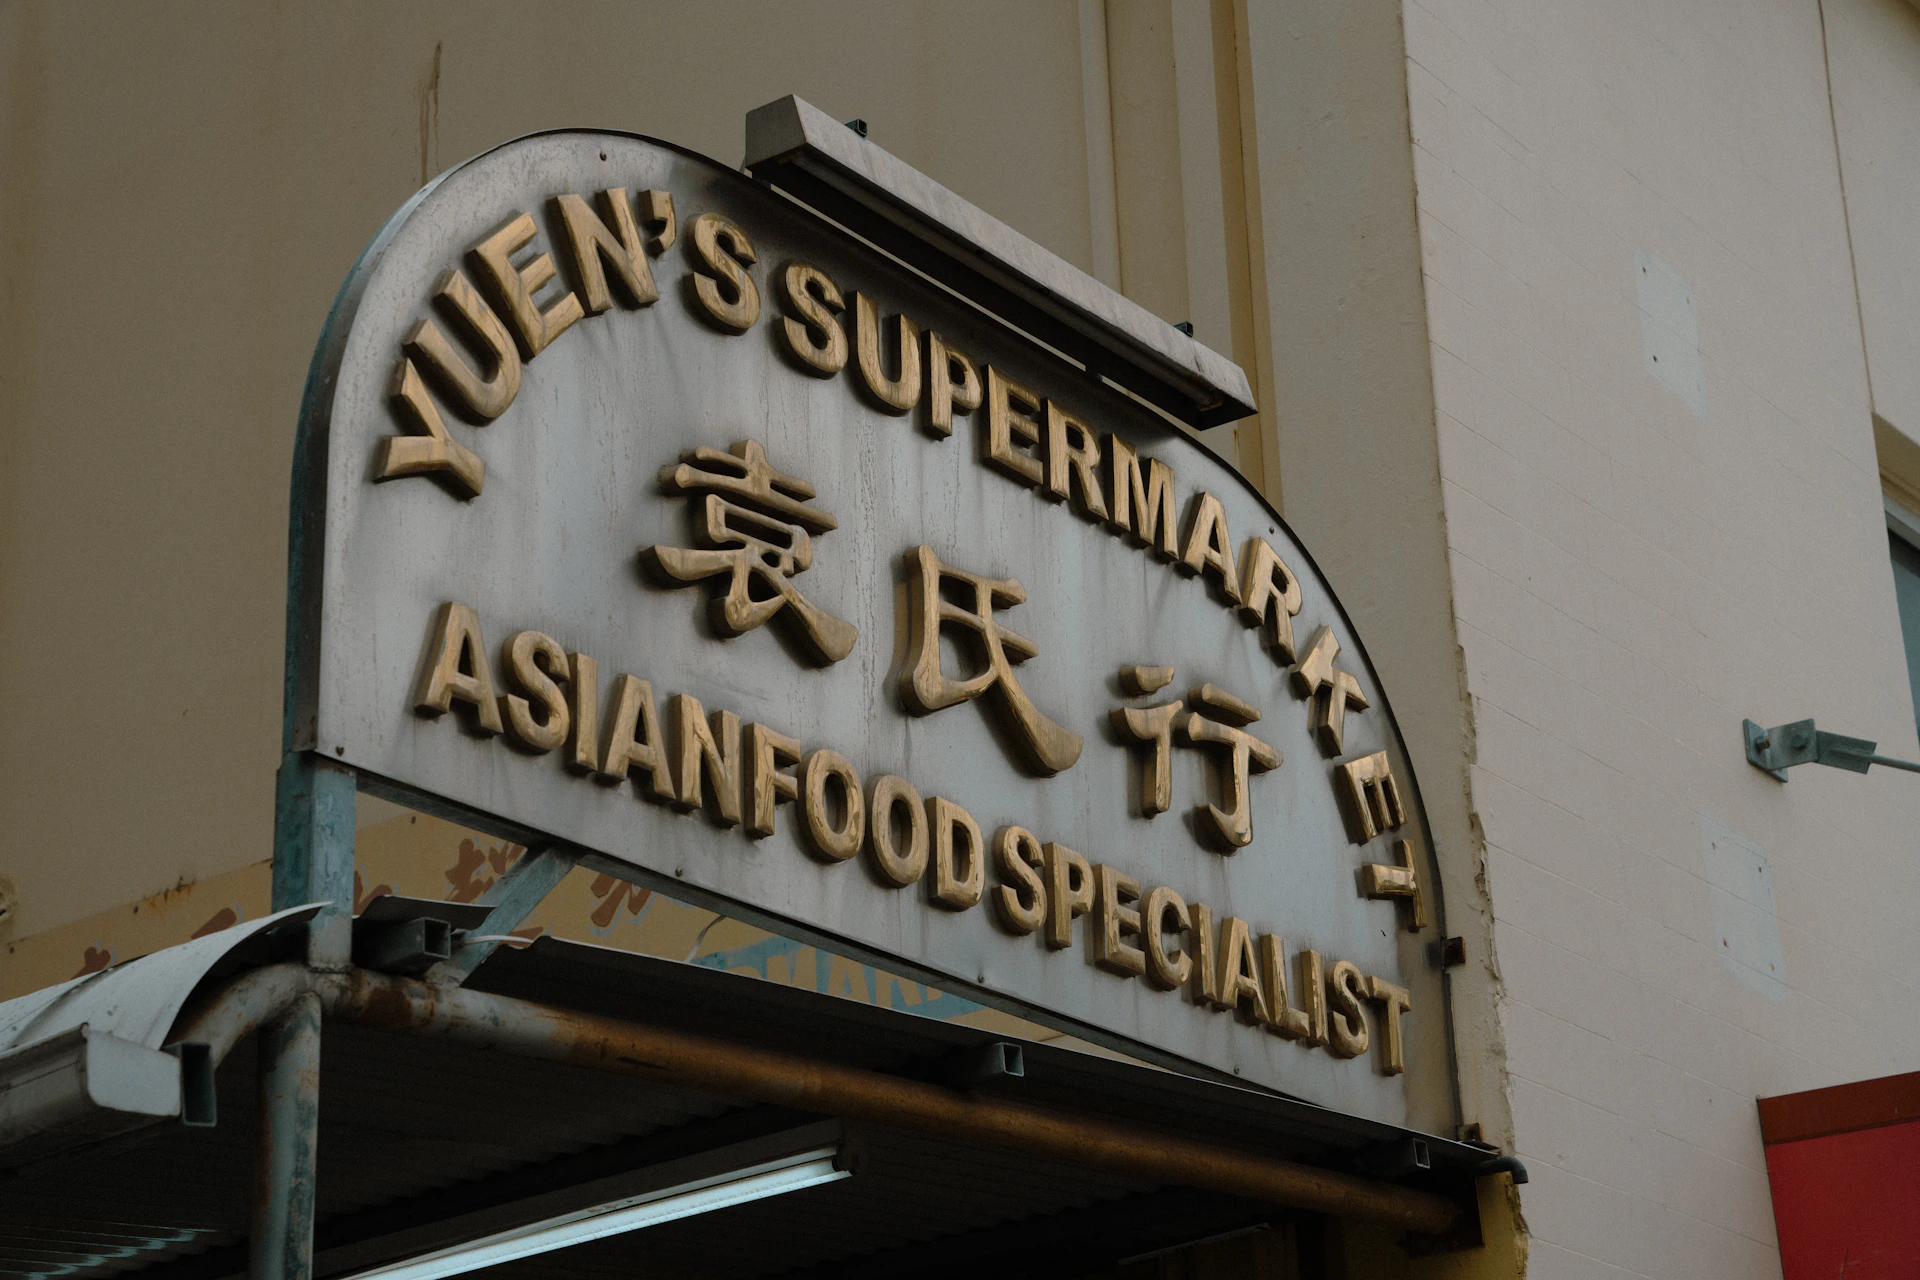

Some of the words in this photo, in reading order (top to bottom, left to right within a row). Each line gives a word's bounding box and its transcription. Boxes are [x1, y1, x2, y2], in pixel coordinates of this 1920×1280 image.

[373, 187, 761, 502] YUEN'S
[781, 261, 1427, 931] SUPERMARKET
[415, 601, 741, 828] ASIAN
[744, 721, 985, 912] FOOD
[999, 825, 1410, 1075] SPECIALIST
